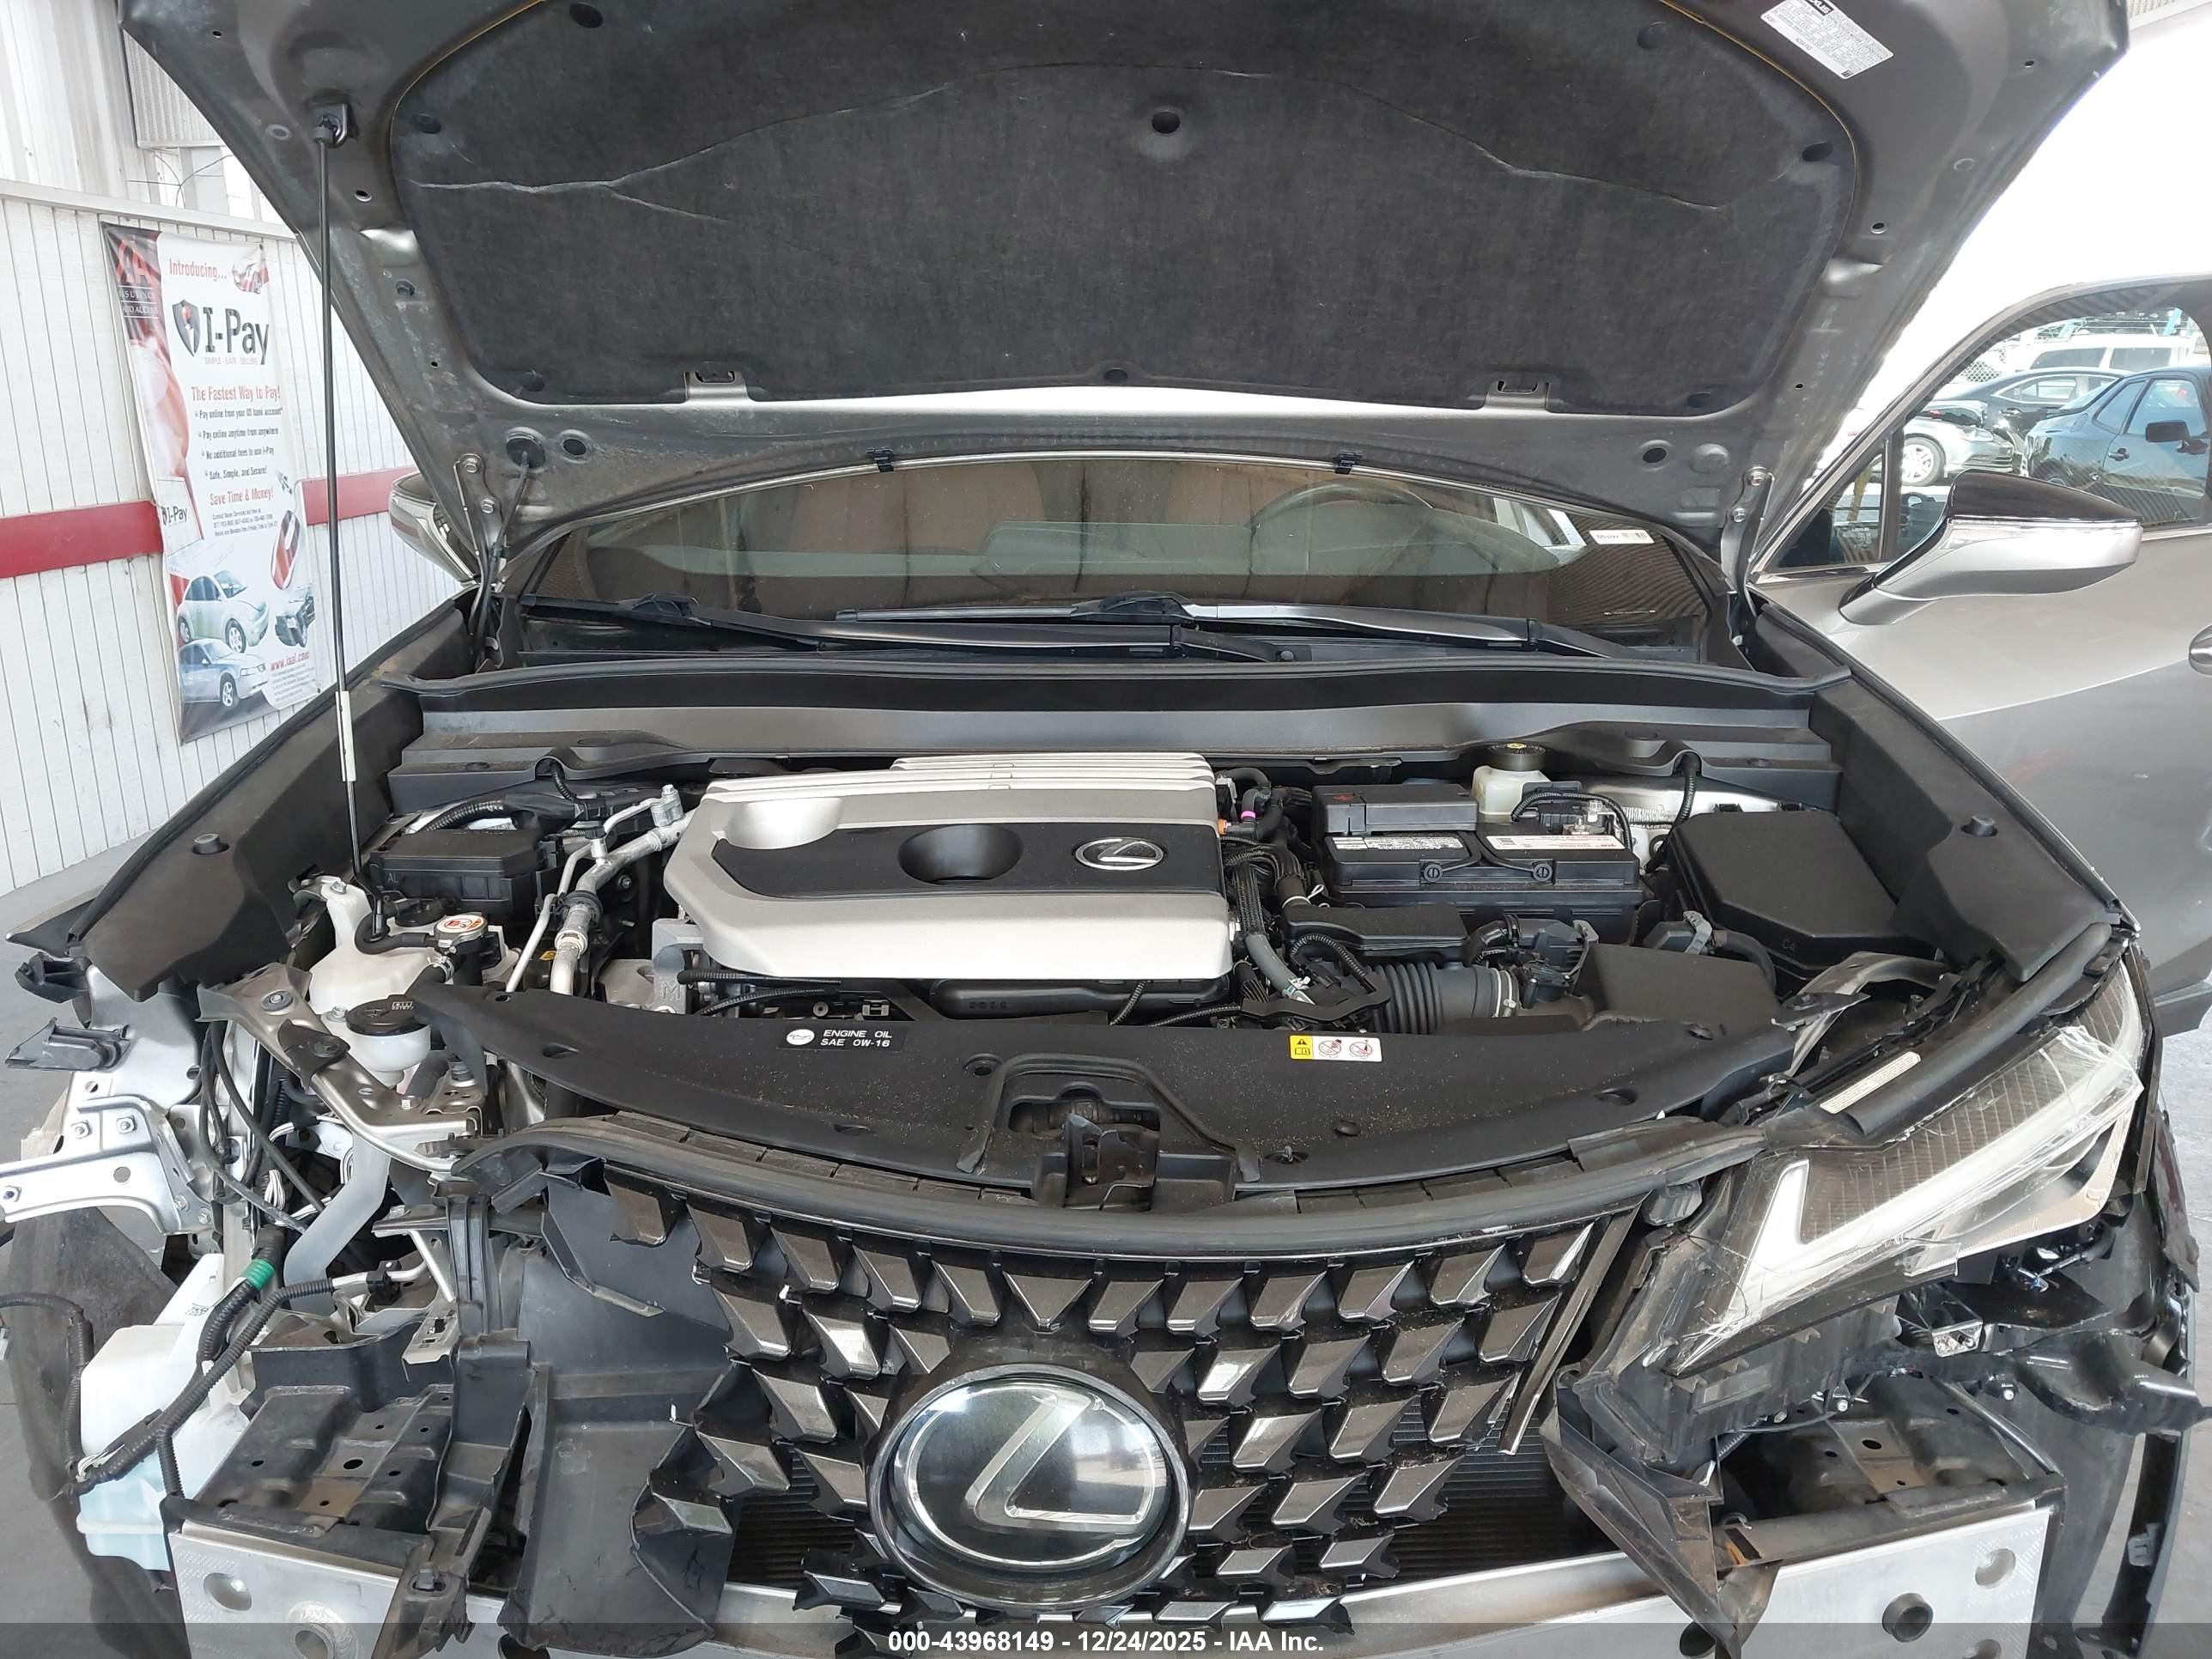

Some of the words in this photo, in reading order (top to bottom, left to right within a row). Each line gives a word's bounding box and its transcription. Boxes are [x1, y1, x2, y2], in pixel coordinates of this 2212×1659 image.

[169, 258, 227, 282] Introducing...
[203, 307, 270, 365] I-Pay
[191, 386, 205, 401] The
[209, 386, 236, 400] Fastest
[239, 386, 253, 402] Way
[256, 386, 263, 399] to
[265, 385, 281, 402] Pay!
[199, 410, 208, 420] Pay
[203, 430, 211, 440] Pay
[210, 493, 225, 505] Save
[228, 491, 243, 502] Time
[246, 489, 250, 501] &
[252, 487, 274, 501] Money!
[167, 506, 187, 524] I-Pay
[823, 1030, 868, 1038] ENGINE
[820, 1038, 846, 1047] SAE
[853, 1039, 890, 1048] 0W-16
